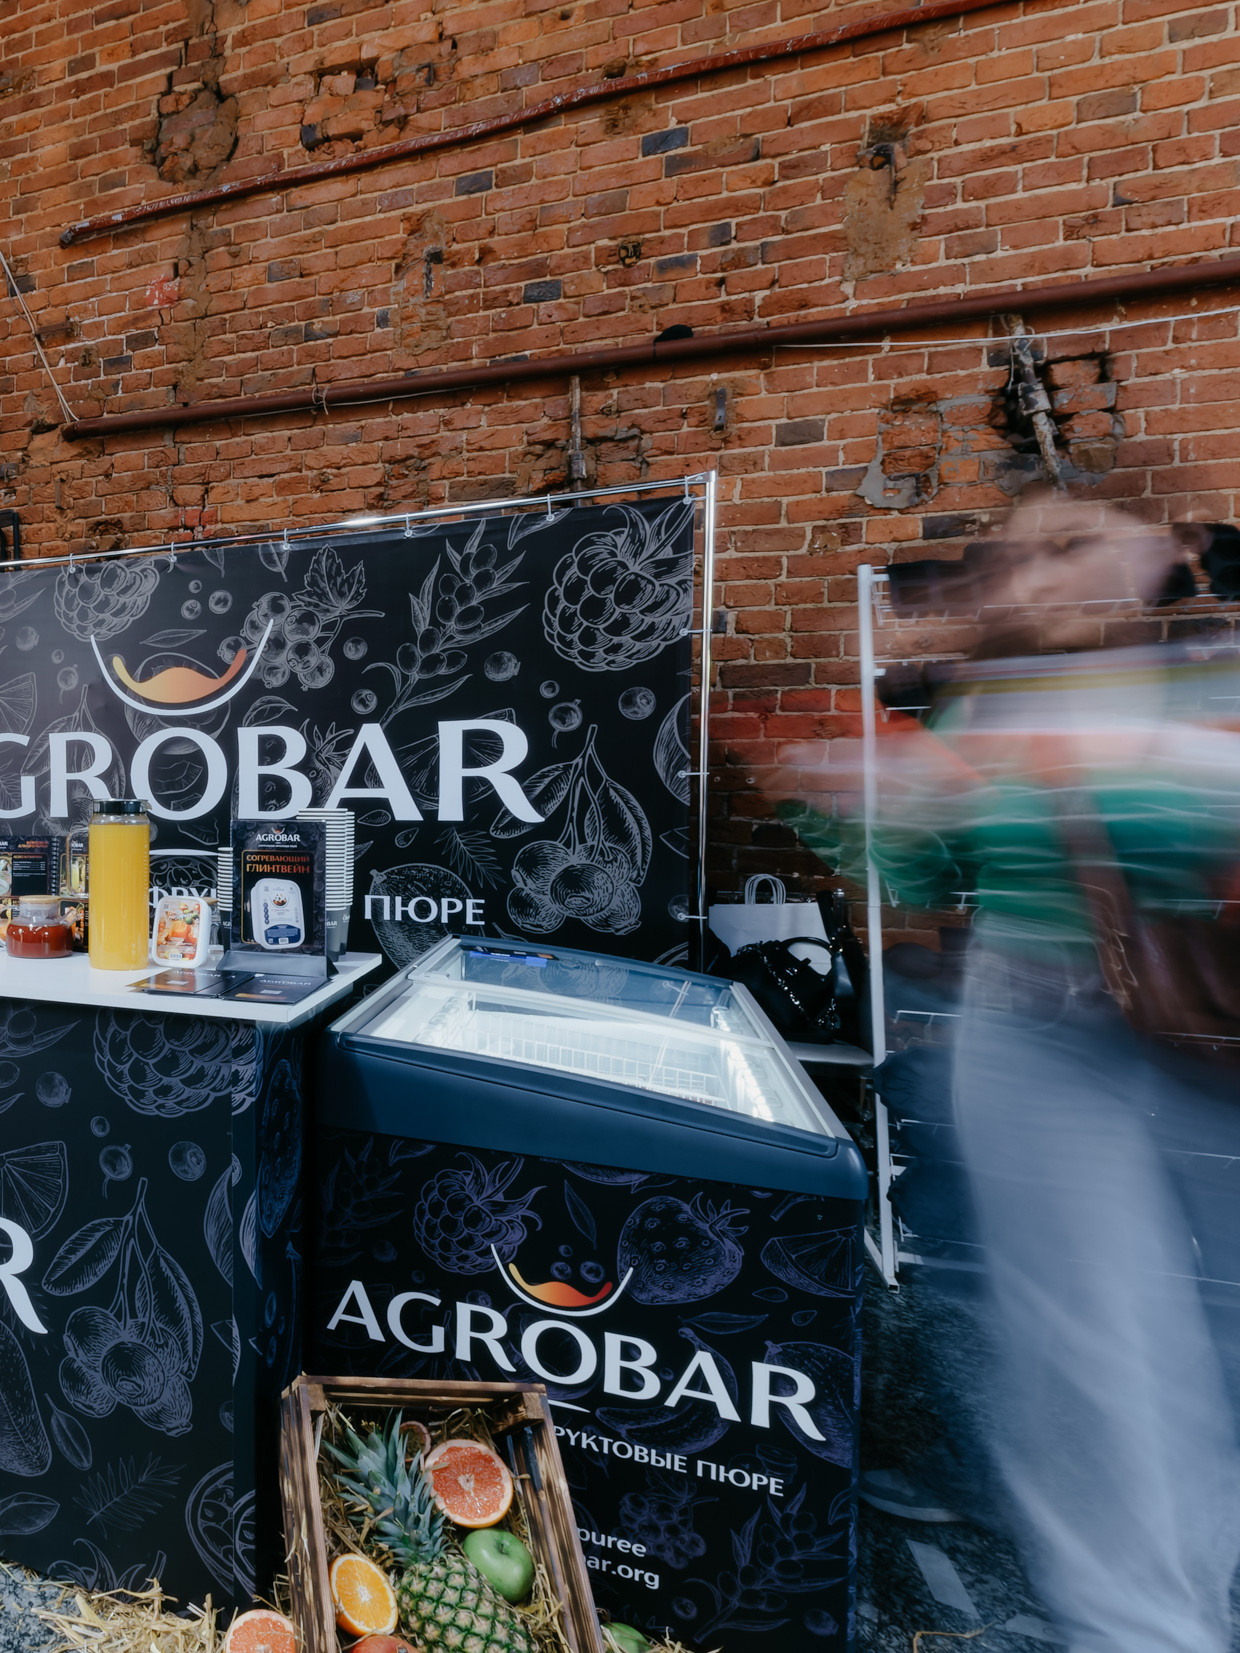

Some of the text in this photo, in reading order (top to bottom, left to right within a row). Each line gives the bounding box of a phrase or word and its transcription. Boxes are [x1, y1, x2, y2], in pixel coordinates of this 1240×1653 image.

[255, 833, 301, 842] AGROBAR
[246, 863, 310, 873] ГЛИНТВЕЙН
[364, 894, 485, 926] ПЮРЕ
[326, 1280, 827, 1442] AGROBAR
[553, 1425, 785, 1497] РУКТОВЫЕ ПЮРЕ
